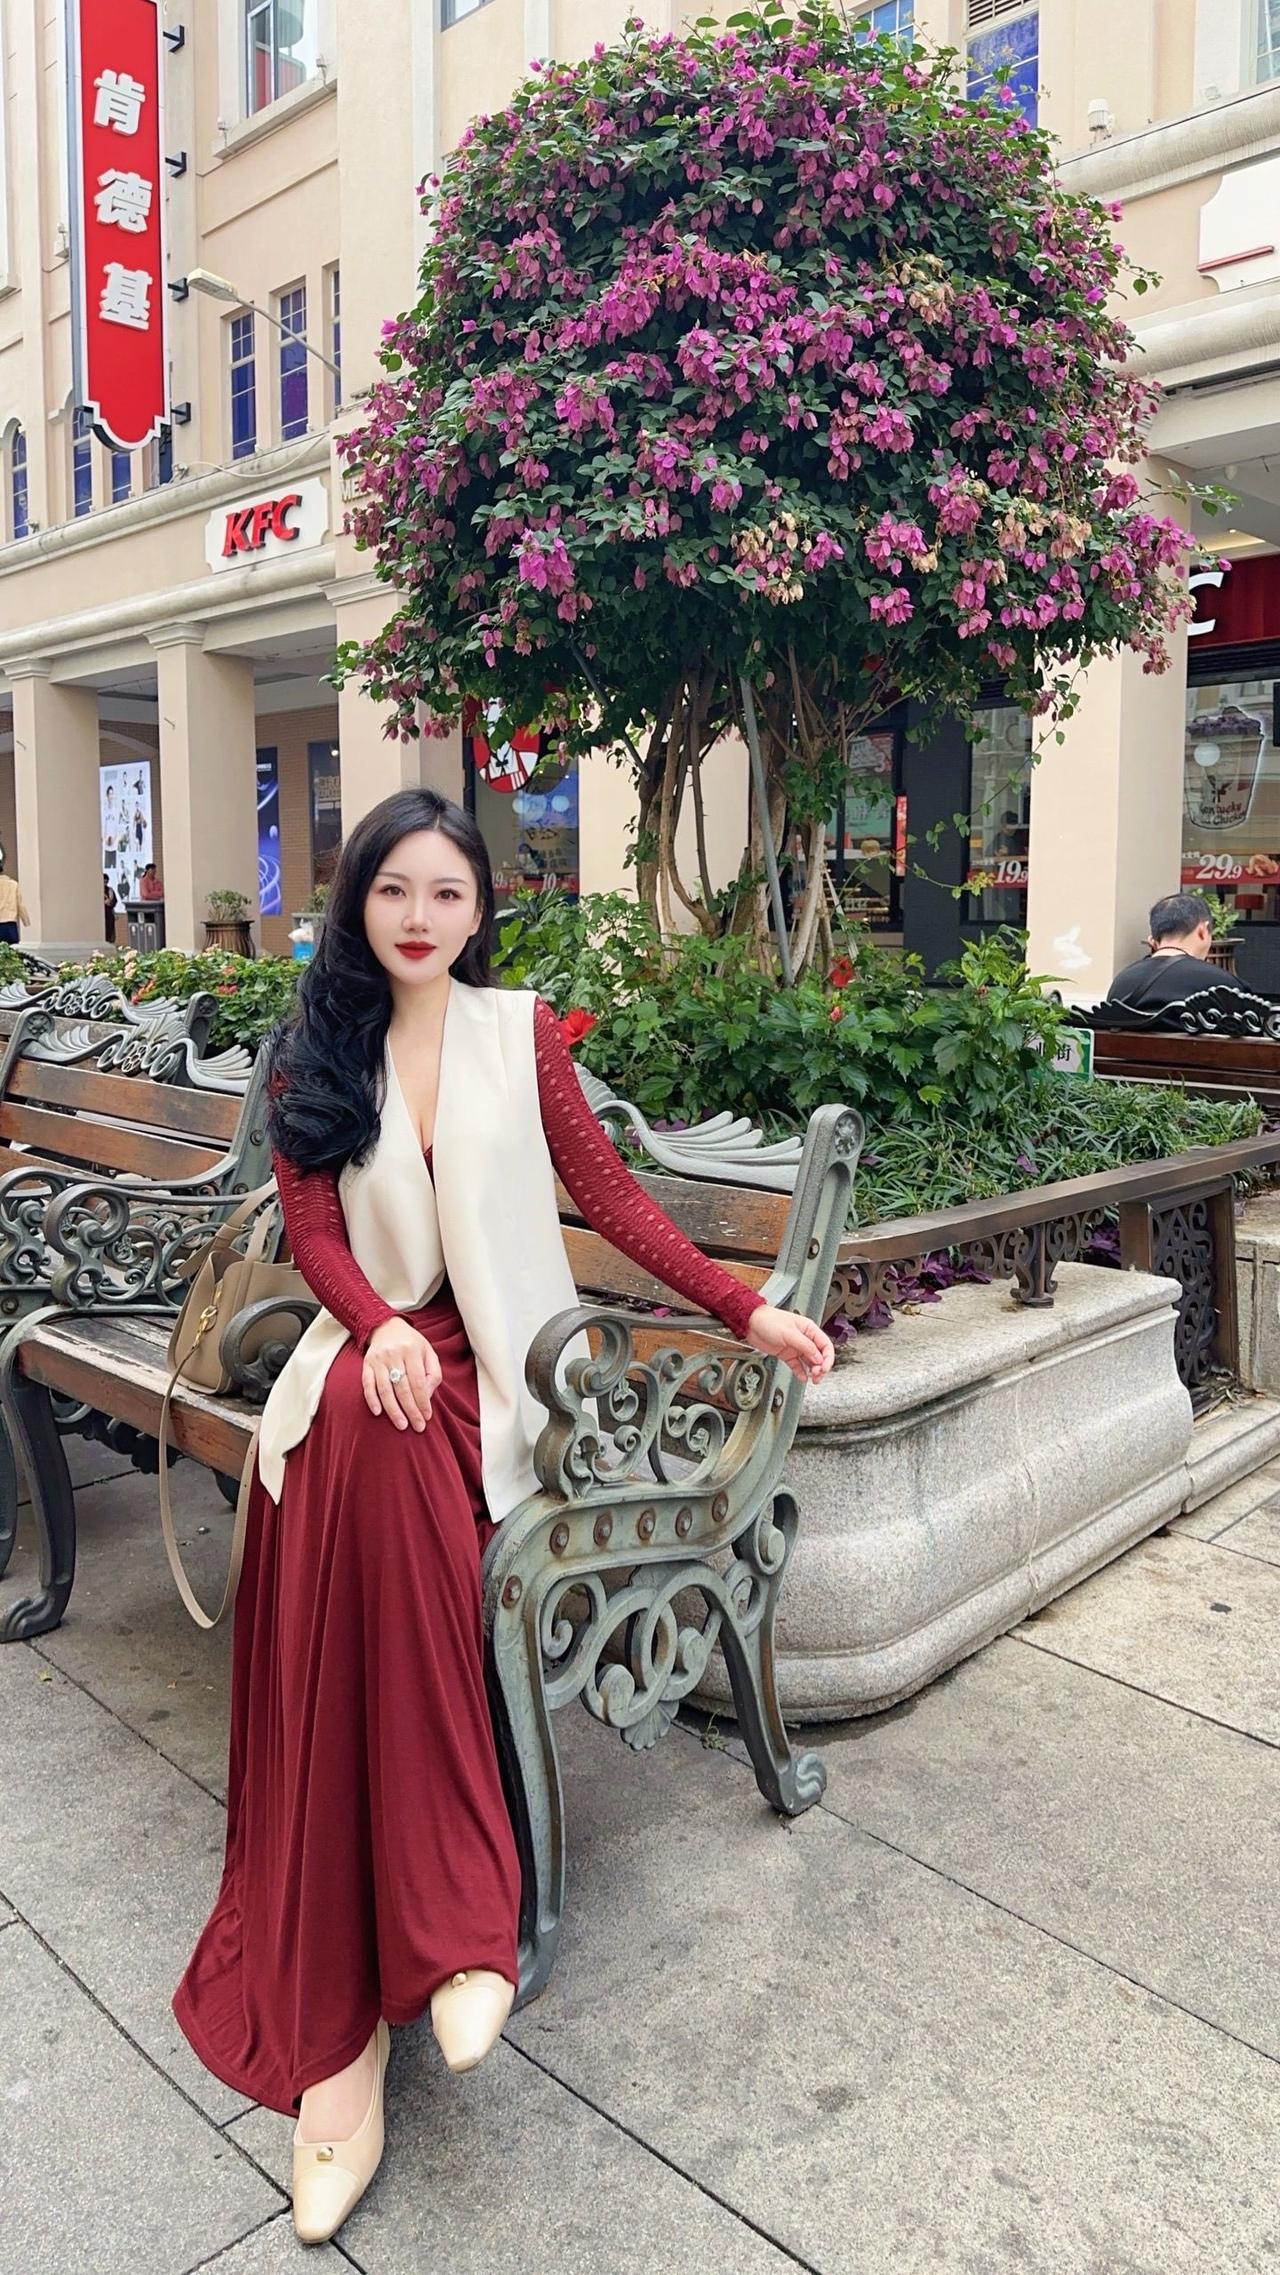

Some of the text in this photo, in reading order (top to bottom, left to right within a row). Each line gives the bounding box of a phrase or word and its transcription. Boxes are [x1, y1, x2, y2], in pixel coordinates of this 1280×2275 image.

[93, 68, 152, 331] 肯德基
[222, 494, 303, 557] KFC
[994, 860, 1028, 884] 19.9
[1195, 853, 1242, 880] 29.9
